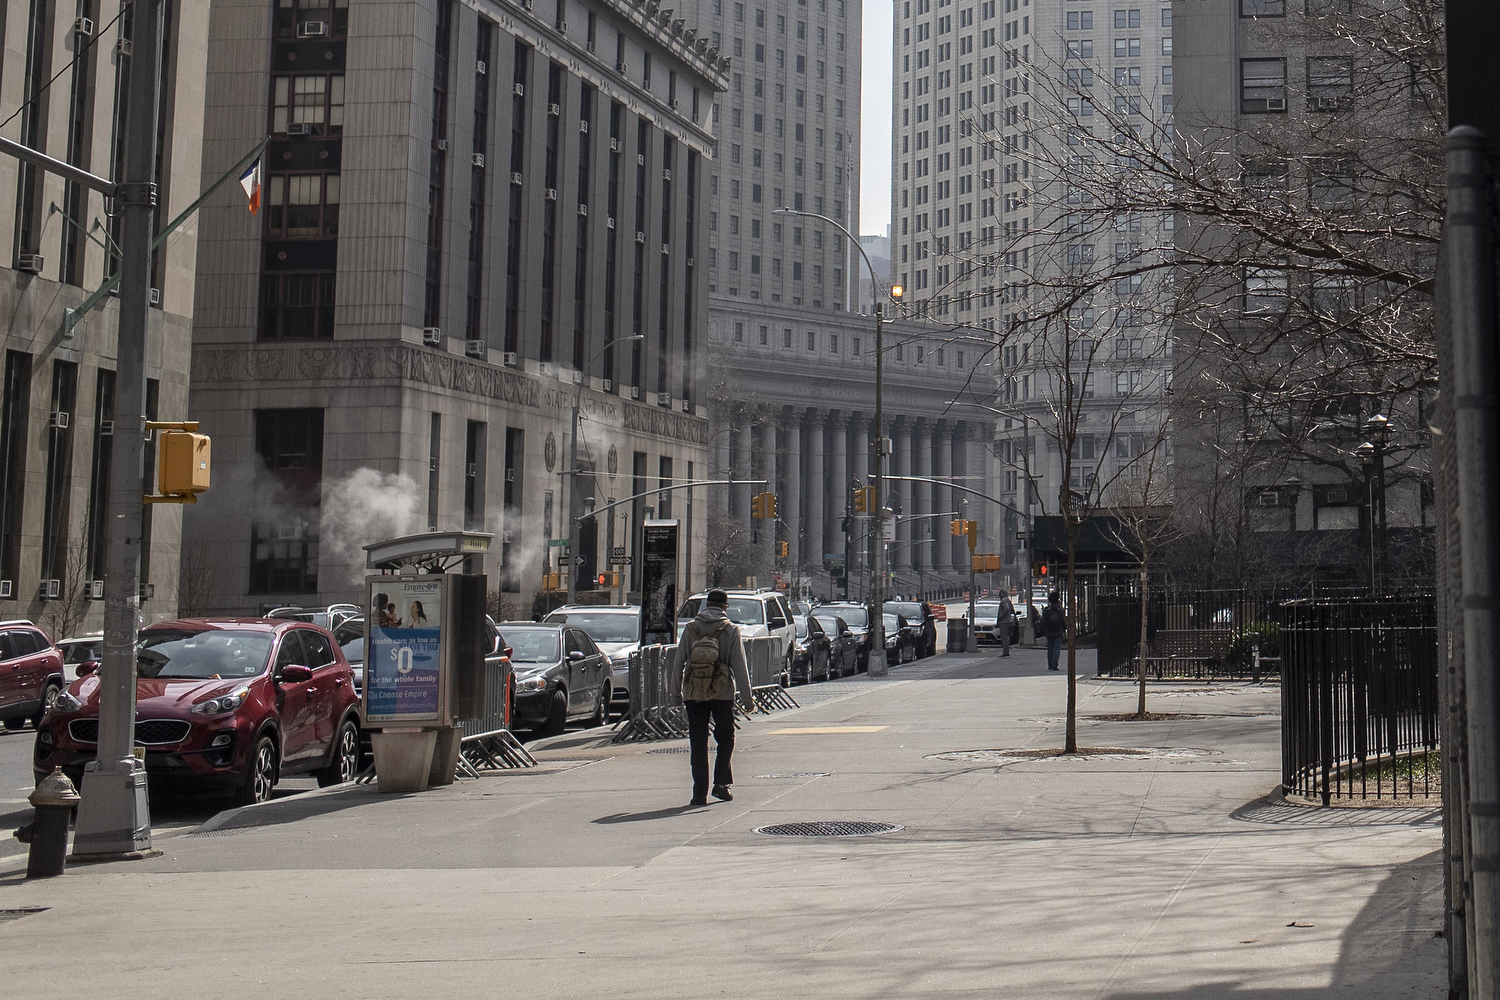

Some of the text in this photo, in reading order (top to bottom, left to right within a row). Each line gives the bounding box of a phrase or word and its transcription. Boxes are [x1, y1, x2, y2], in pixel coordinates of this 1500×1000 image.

[862, 391, 888, 401] COUT
[547, 388, 567, 409] STATE
[600, 401, 617, 420] YORK
[404, 583, 426, 592] Empire
[390, 647, 413, 674] $0
[378, 690, 427, 699] Choose Empire
